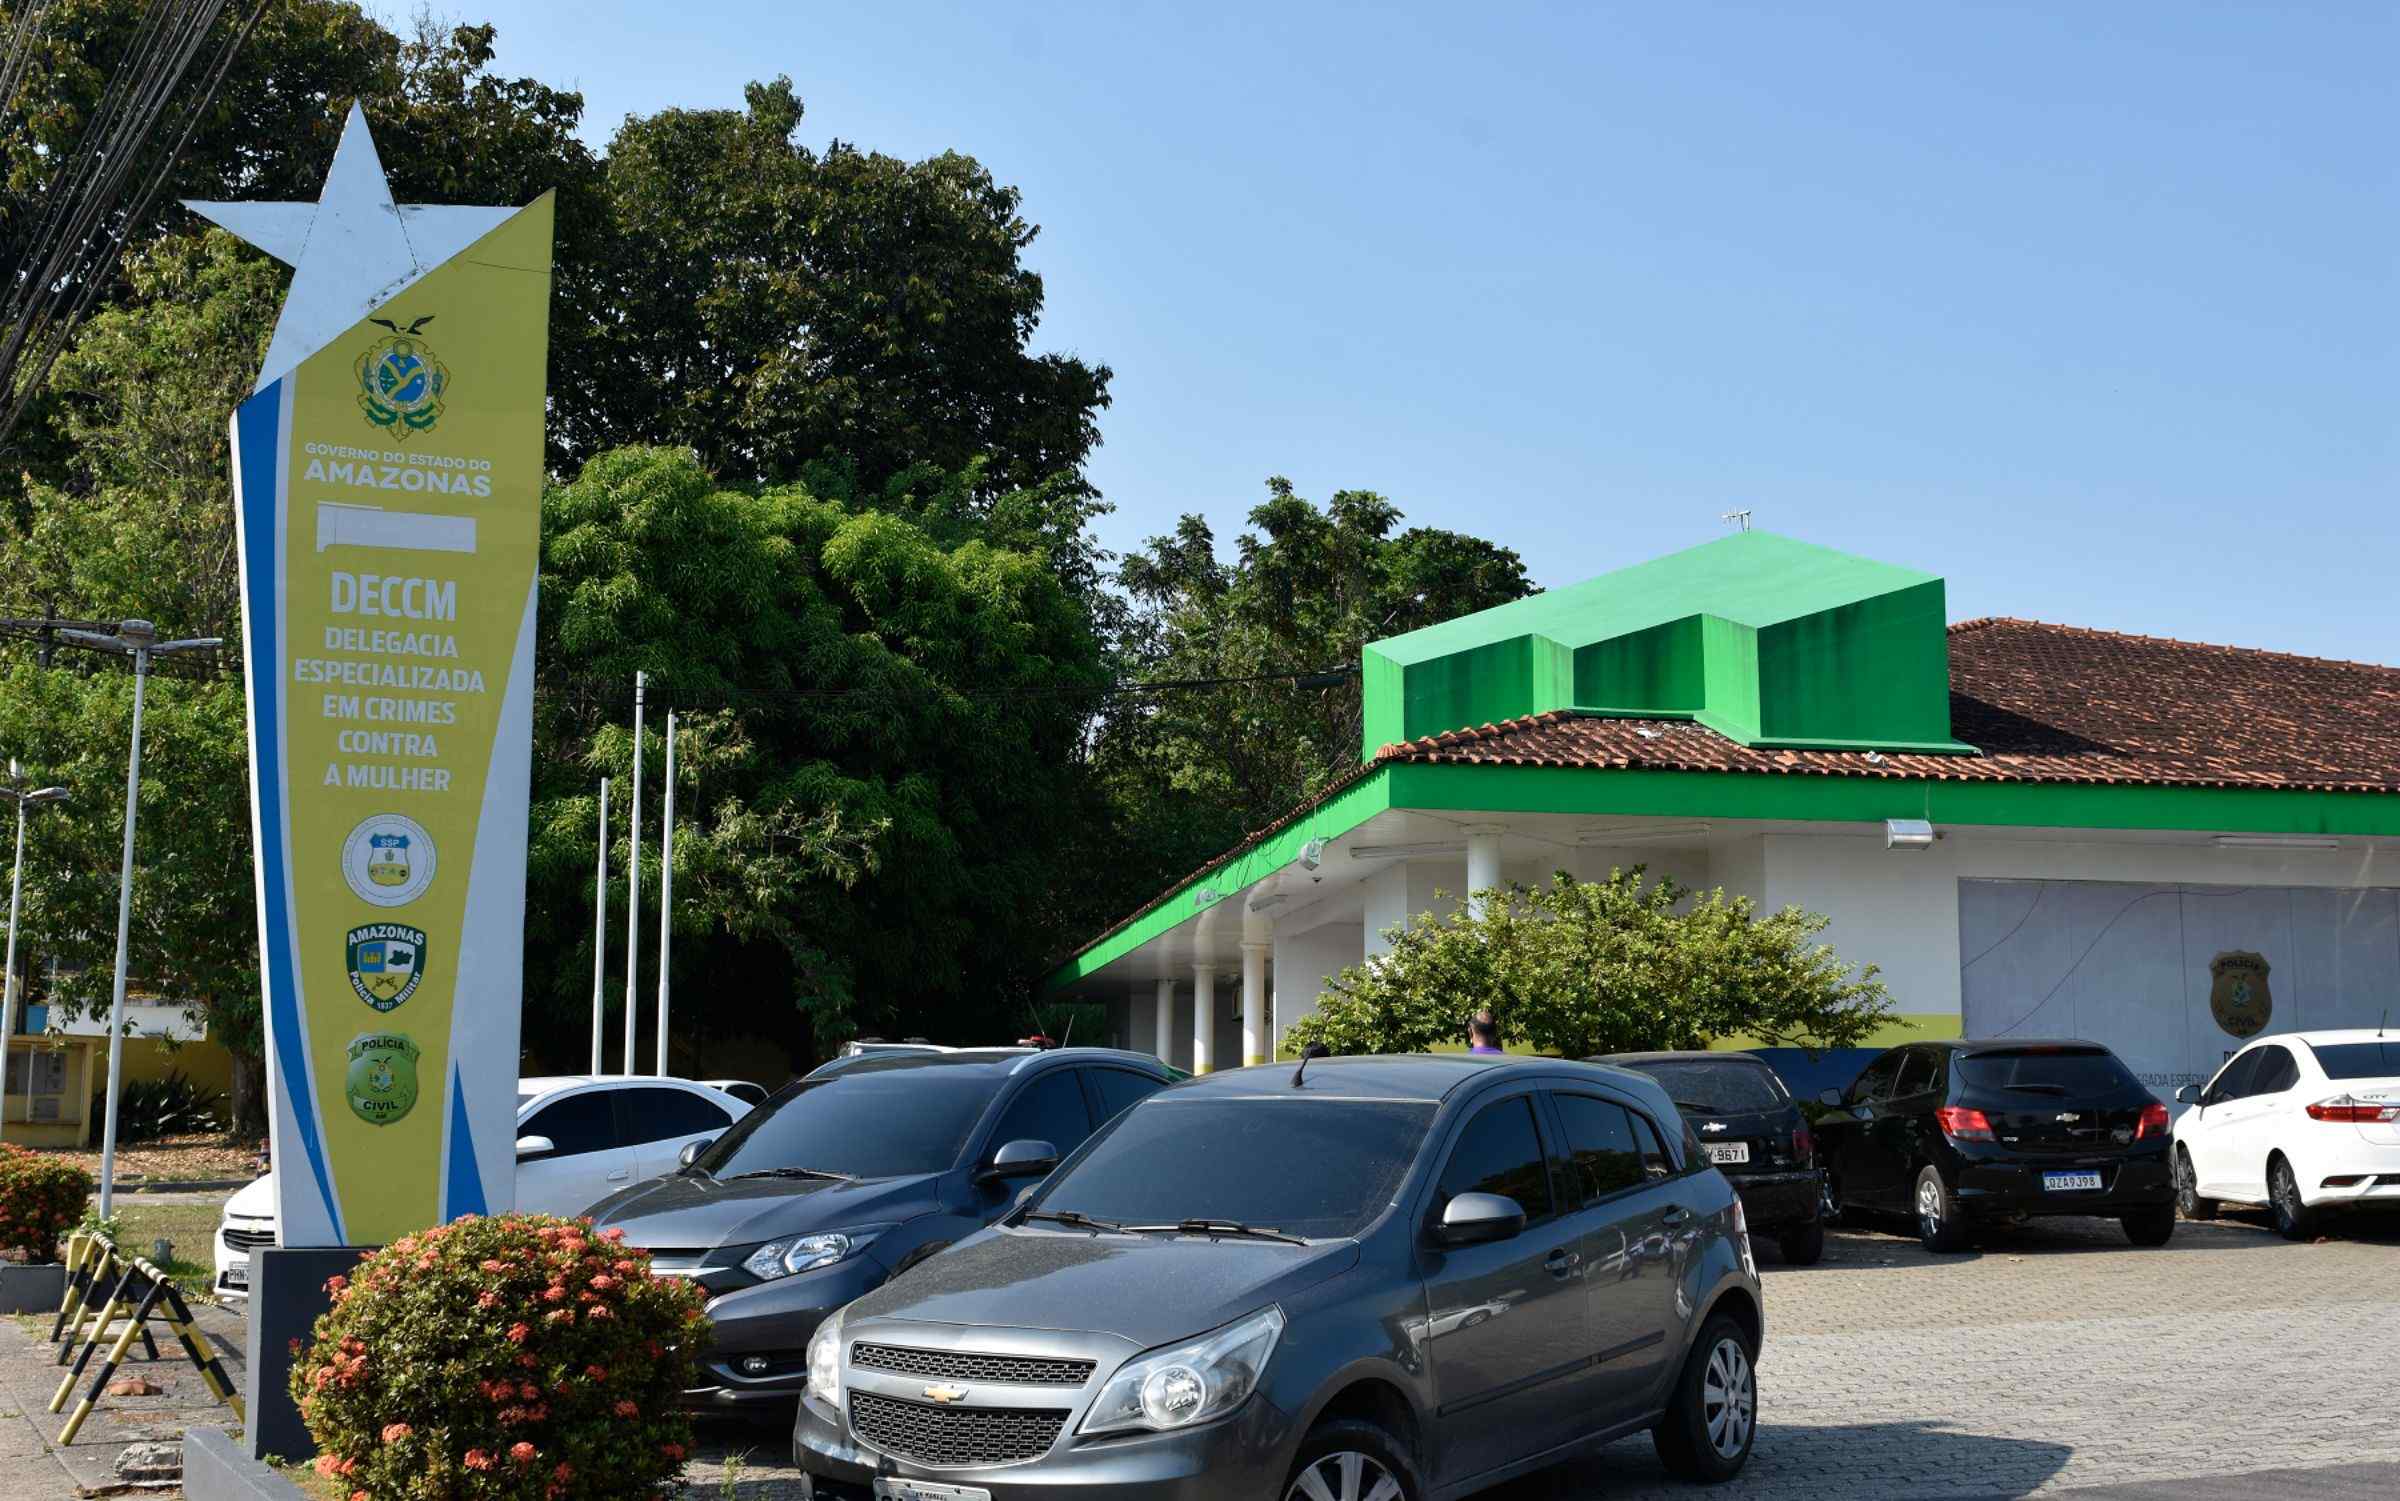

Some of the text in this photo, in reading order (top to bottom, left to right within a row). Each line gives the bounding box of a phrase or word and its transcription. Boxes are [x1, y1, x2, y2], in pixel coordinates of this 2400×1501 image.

[304, 442, 491, 471] GOVERNO DO ESTADO DO
[304, 459, 492, 497] AMAZONAS
[331, 571, 456, 621] DECCM
[325, 626, 459, 658] DELEGACIA
[294, 658, 486, 692] ESPECIALIZADA
[323, 694, 456, 724] EM CRIMES
[338, 730, 438, 757] CONTRA
[323, 763, 450, 791] A MULHER
[381, 838, 400, 847] SSP
[349, 925, 425, 946] AMAZONAS
[394, 971, 421, 1003] Militar
[363, 1101, 399, 1111] CIVIL
